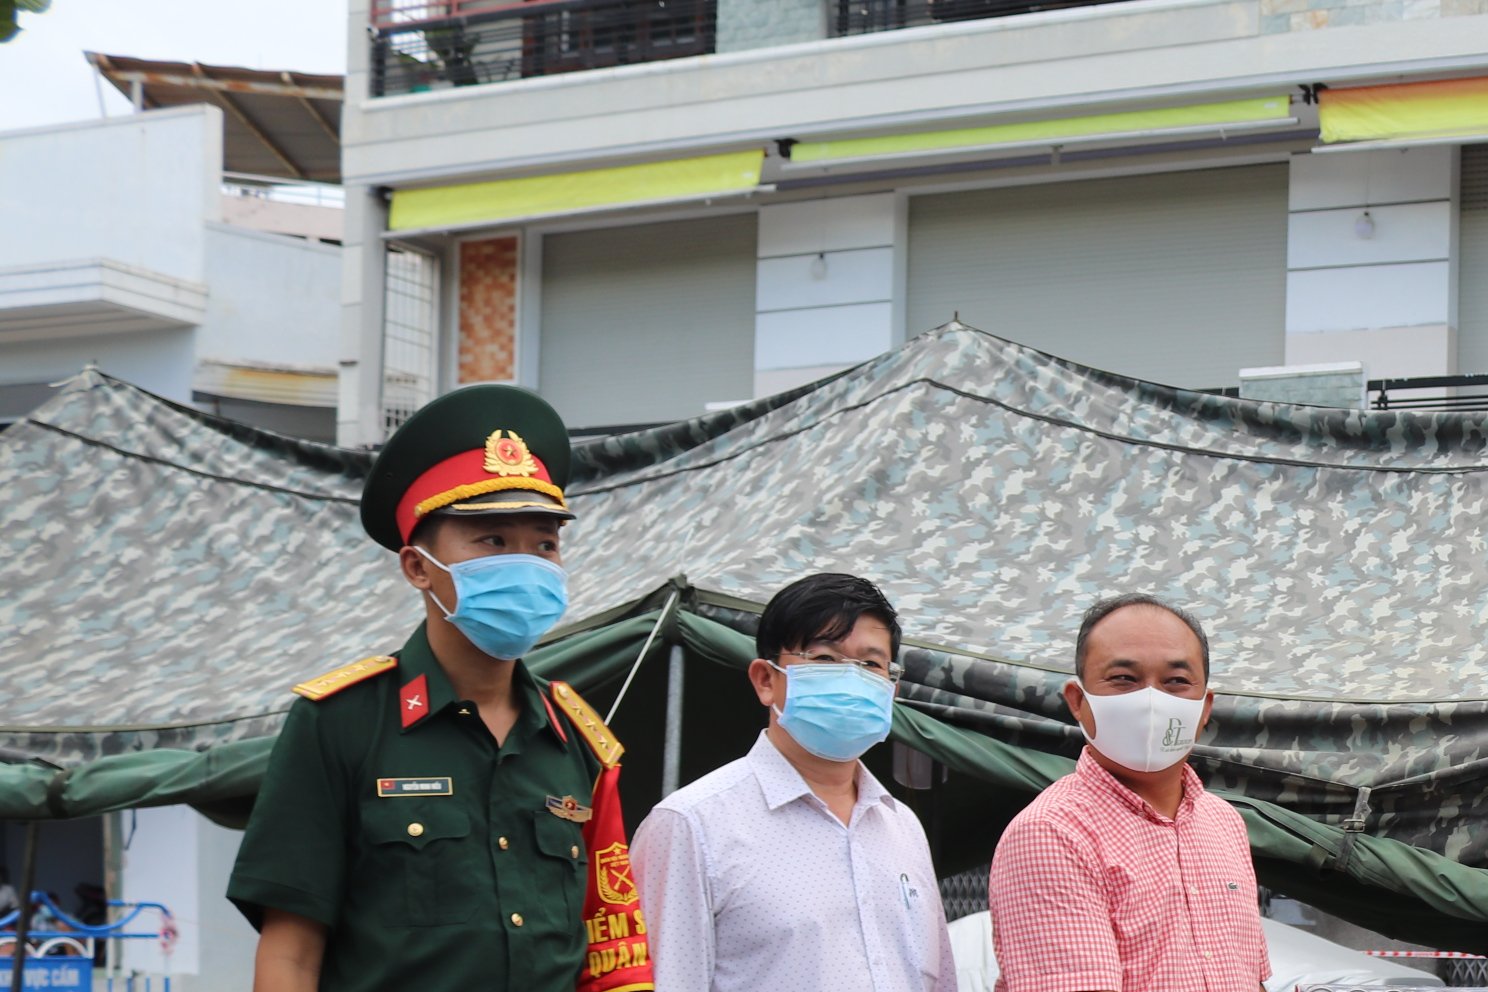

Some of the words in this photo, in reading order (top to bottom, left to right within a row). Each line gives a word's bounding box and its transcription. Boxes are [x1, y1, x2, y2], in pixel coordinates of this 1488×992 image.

[586, 907, 629, 944] IỂM
[633, 909, 647, 935] S
[588, 941, 647, 978] QUÂN
